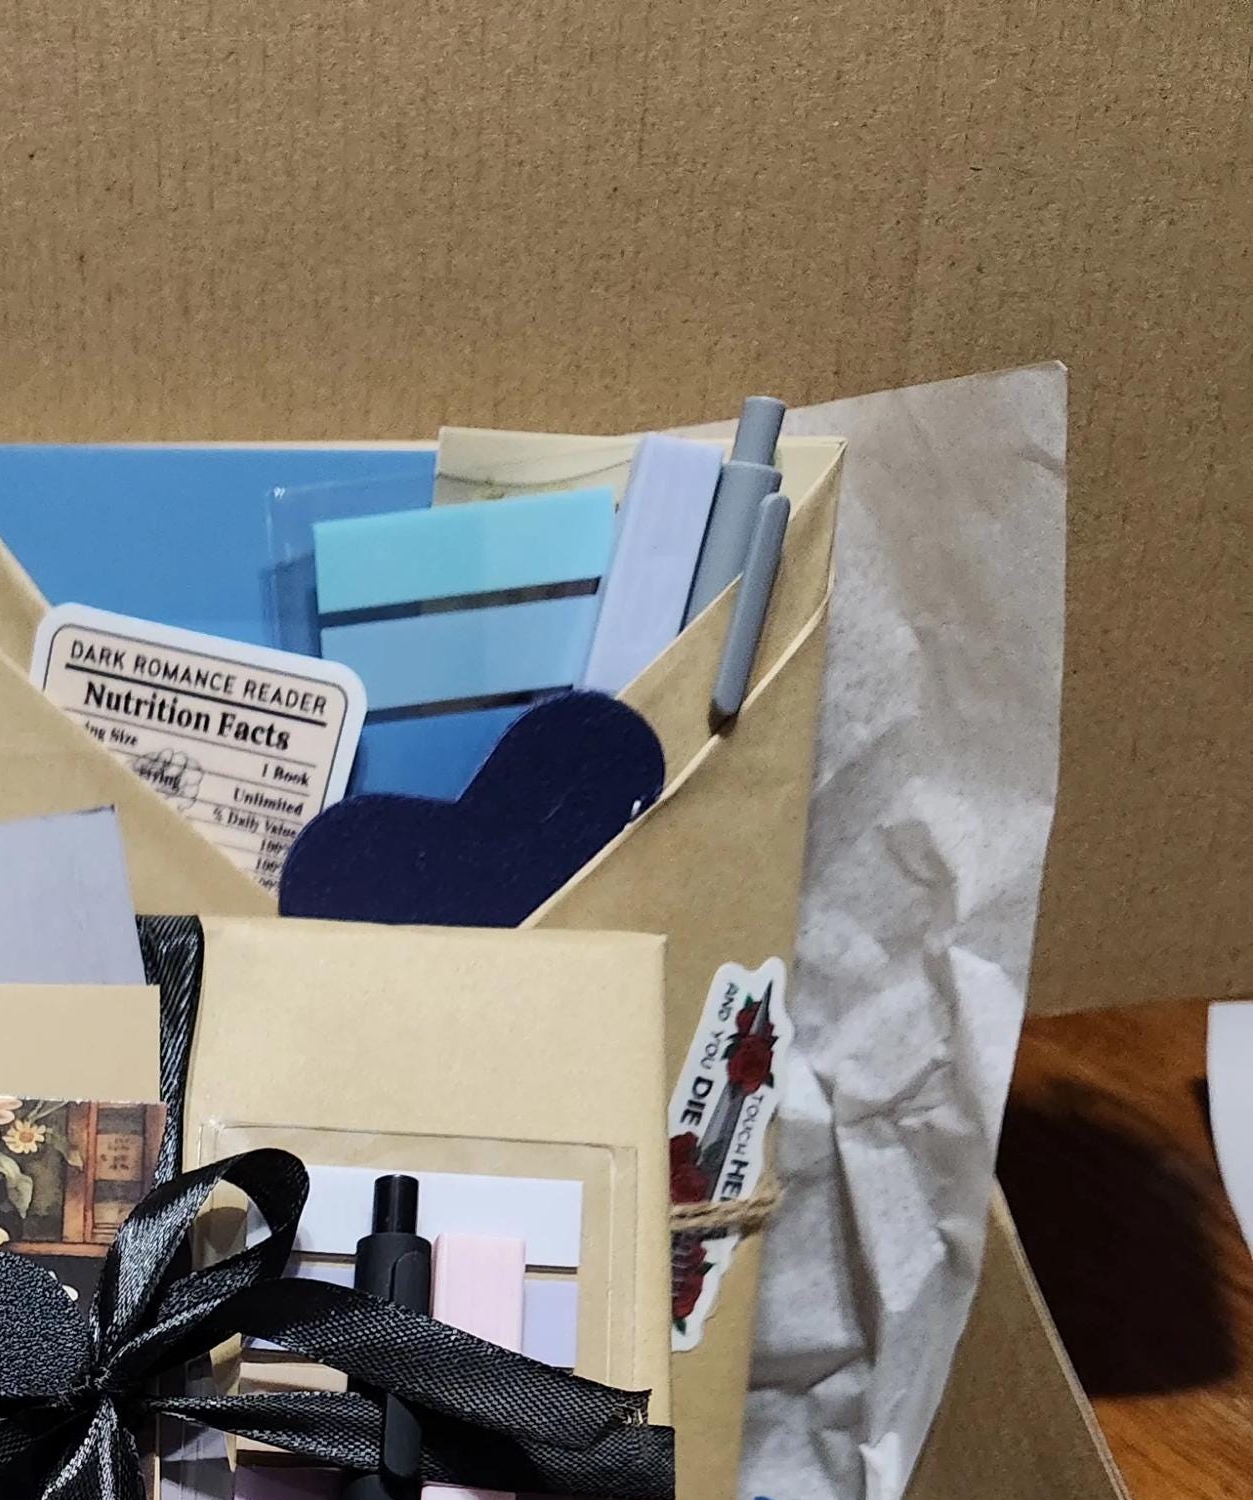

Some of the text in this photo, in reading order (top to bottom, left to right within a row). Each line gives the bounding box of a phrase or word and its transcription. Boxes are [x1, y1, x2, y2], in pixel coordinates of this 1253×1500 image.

[70, 640, 327, 716] DARK ROMANCE READER
[84, 681, 211, 732] Nutrition
[217, 712, 292, 751] Facts
[233, 787, 304, 817] Unlimited
[273, 766, 309, 787] Book
[226, 812, 259, 834] Daily
[680, 982, 739, 1127] AND YOU DIE
[720, 1095, 765, 1201] TOUCH HE
